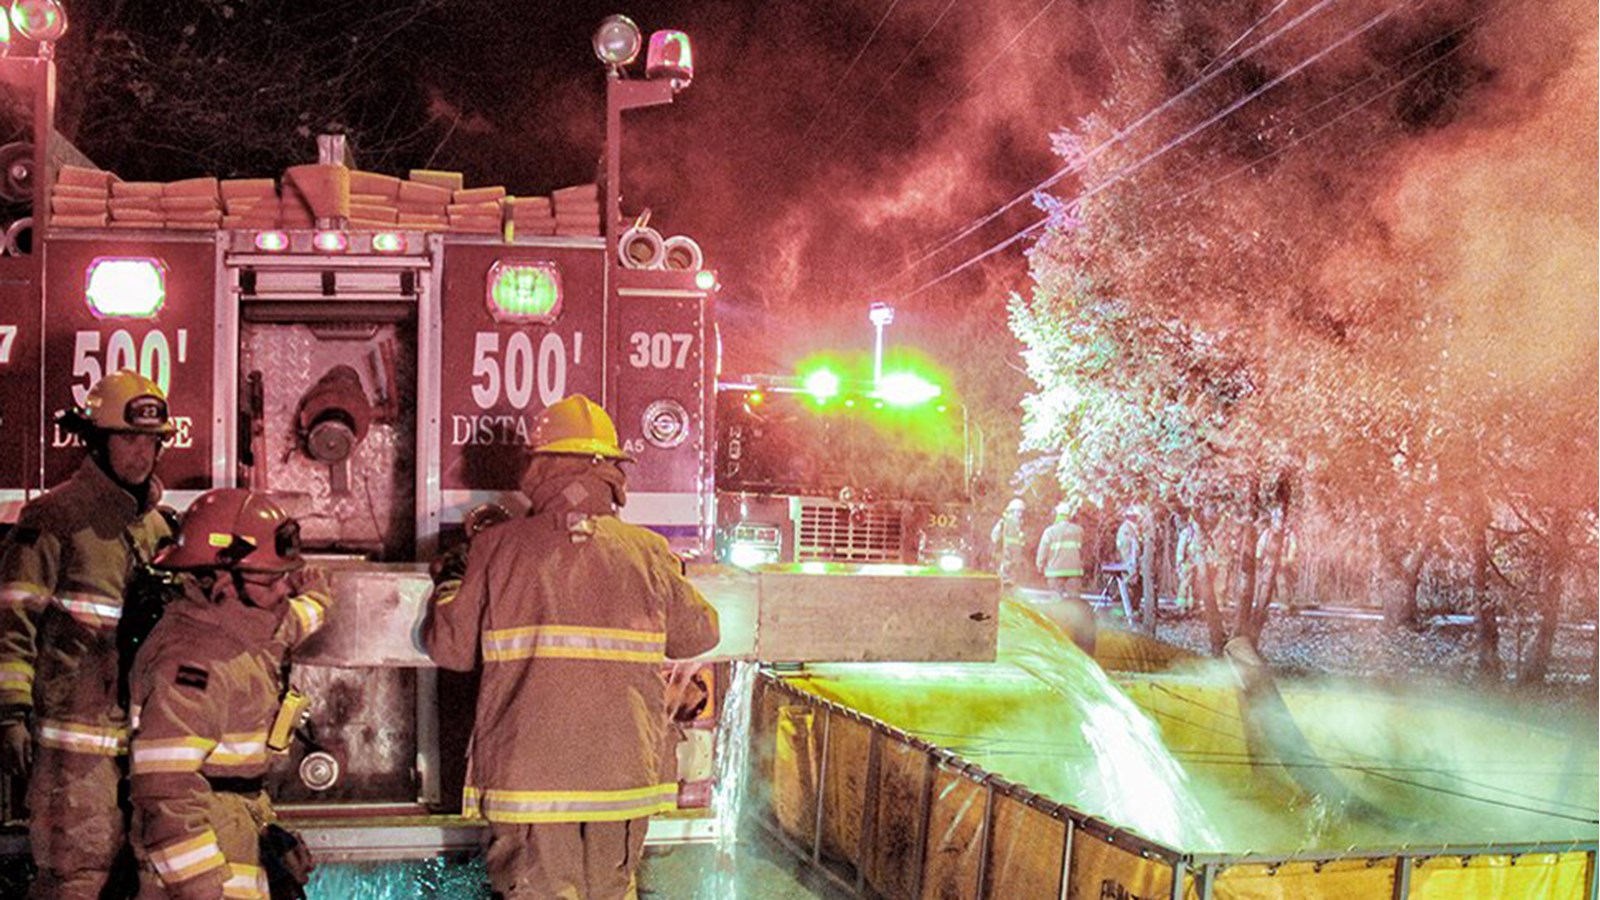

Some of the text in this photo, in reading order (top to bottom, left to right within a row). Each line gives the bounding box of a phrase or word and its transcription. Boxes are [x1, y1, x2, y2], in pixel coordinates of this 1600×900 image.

[629, 331, 694, 369] 307
[451, 414, 531, 446] DISTA
[928, 513, 958, 528] 302
